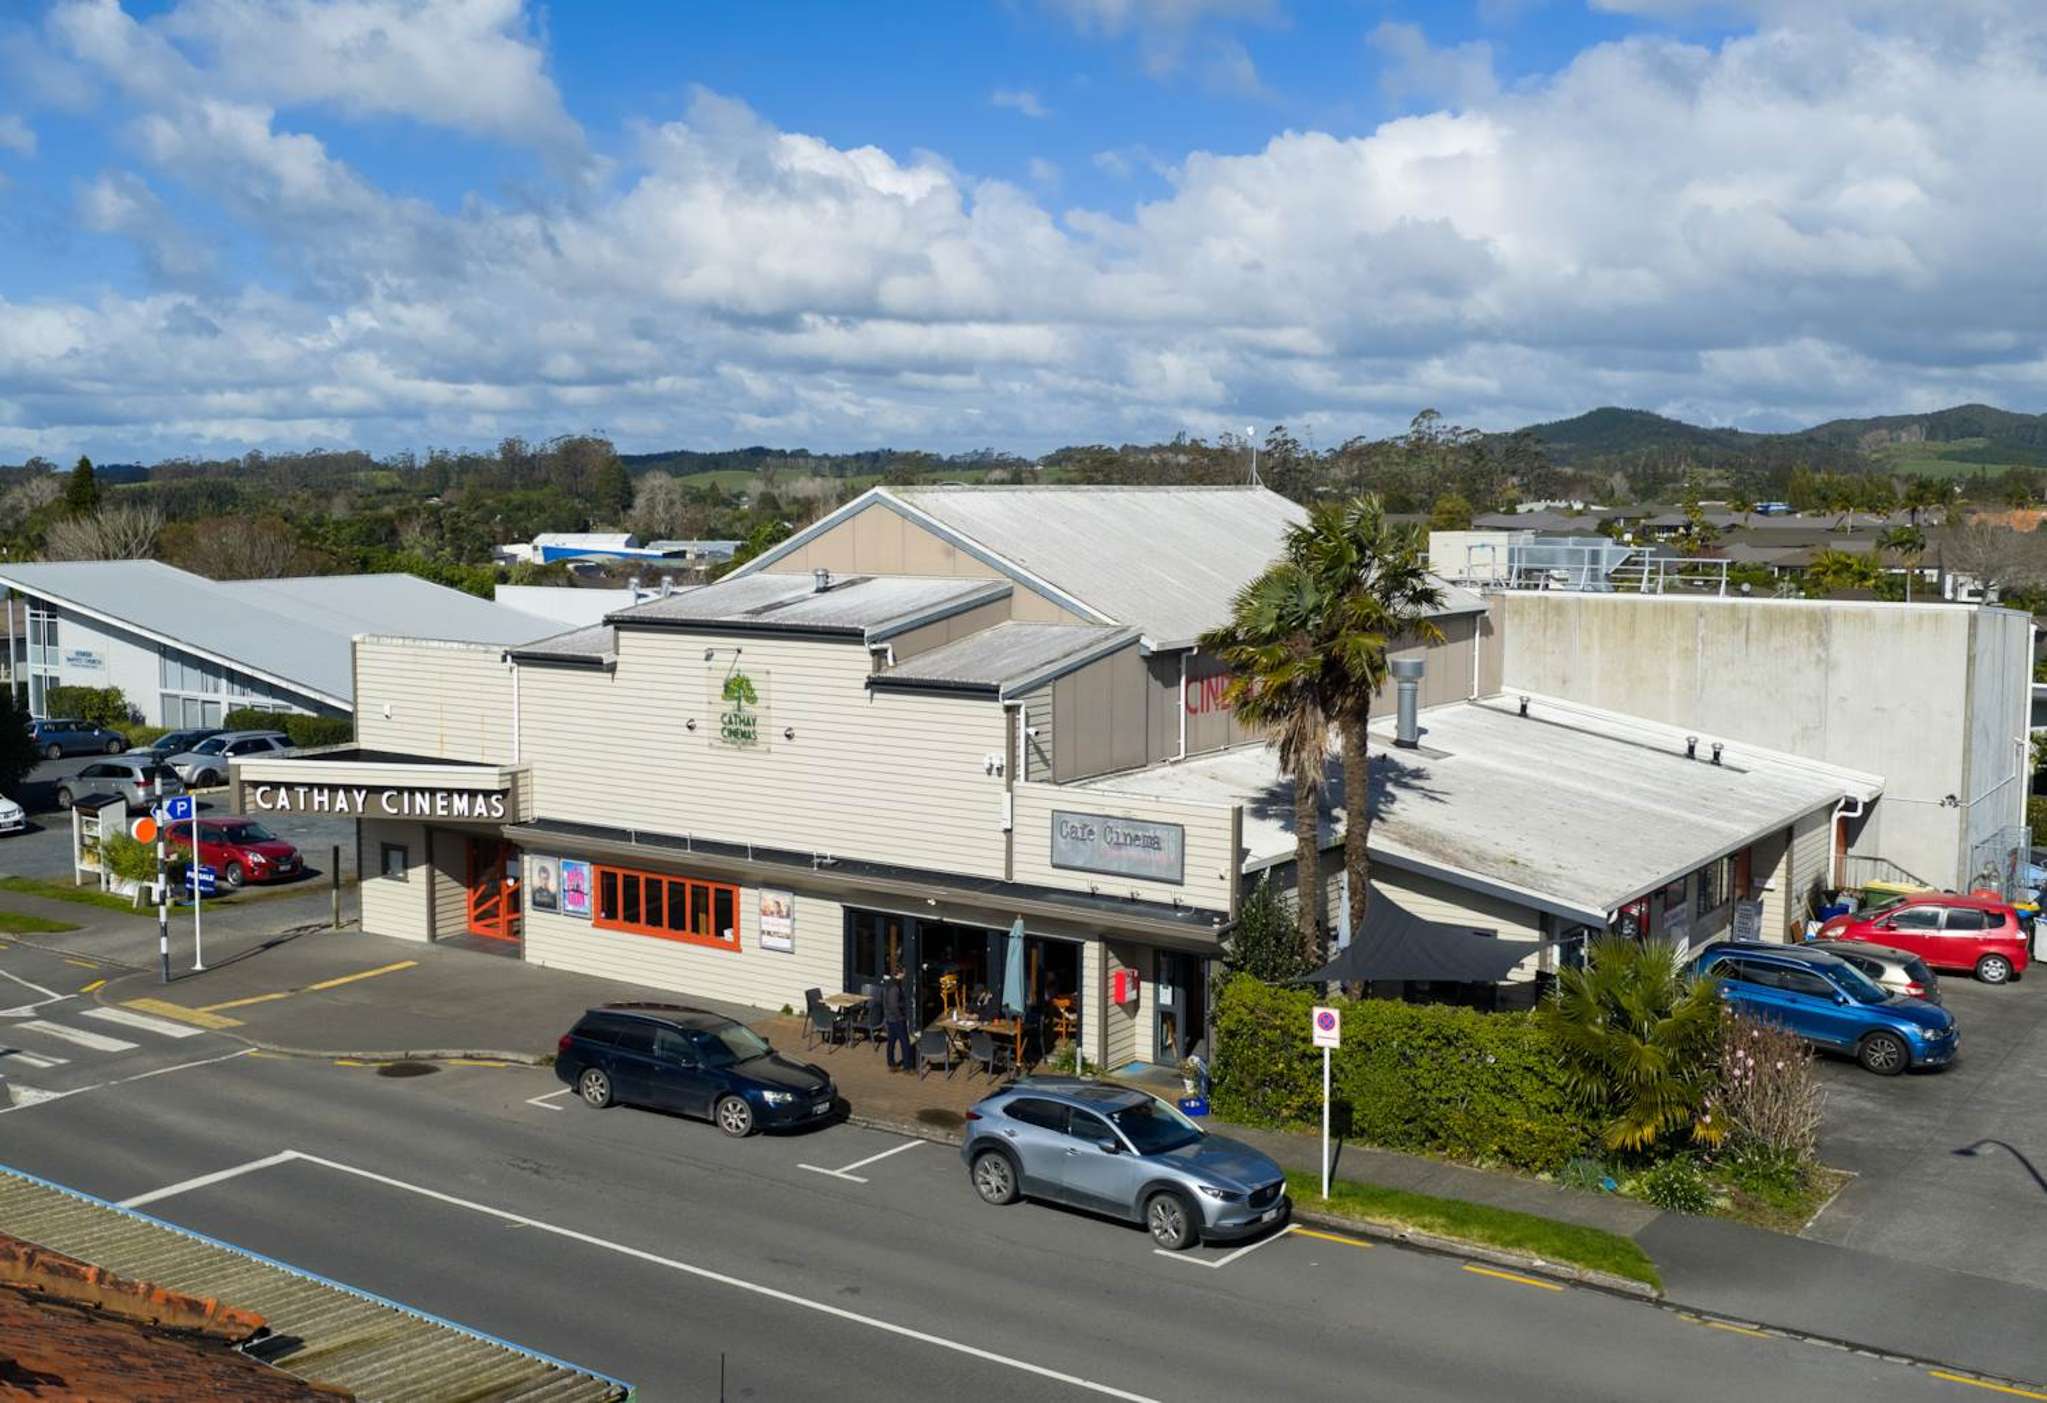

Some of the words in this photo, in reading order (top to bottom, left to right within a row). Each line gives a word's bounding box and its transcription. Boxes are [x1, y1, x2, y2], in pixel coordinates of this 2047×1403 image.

[1185, 671, 1258, 714] CINE
[720, 712, 757, 727] CATHAY
[720, 726, 758, 741] CINEMAS
[176, 801, 188, 817] P
[255, 785, 368, 813] CATHAY
[381, 789, 505, 818] CINEMAS
[1060, 820, 1096, 842] Cafe
[1103, 825, 1162, 851] Cinema
